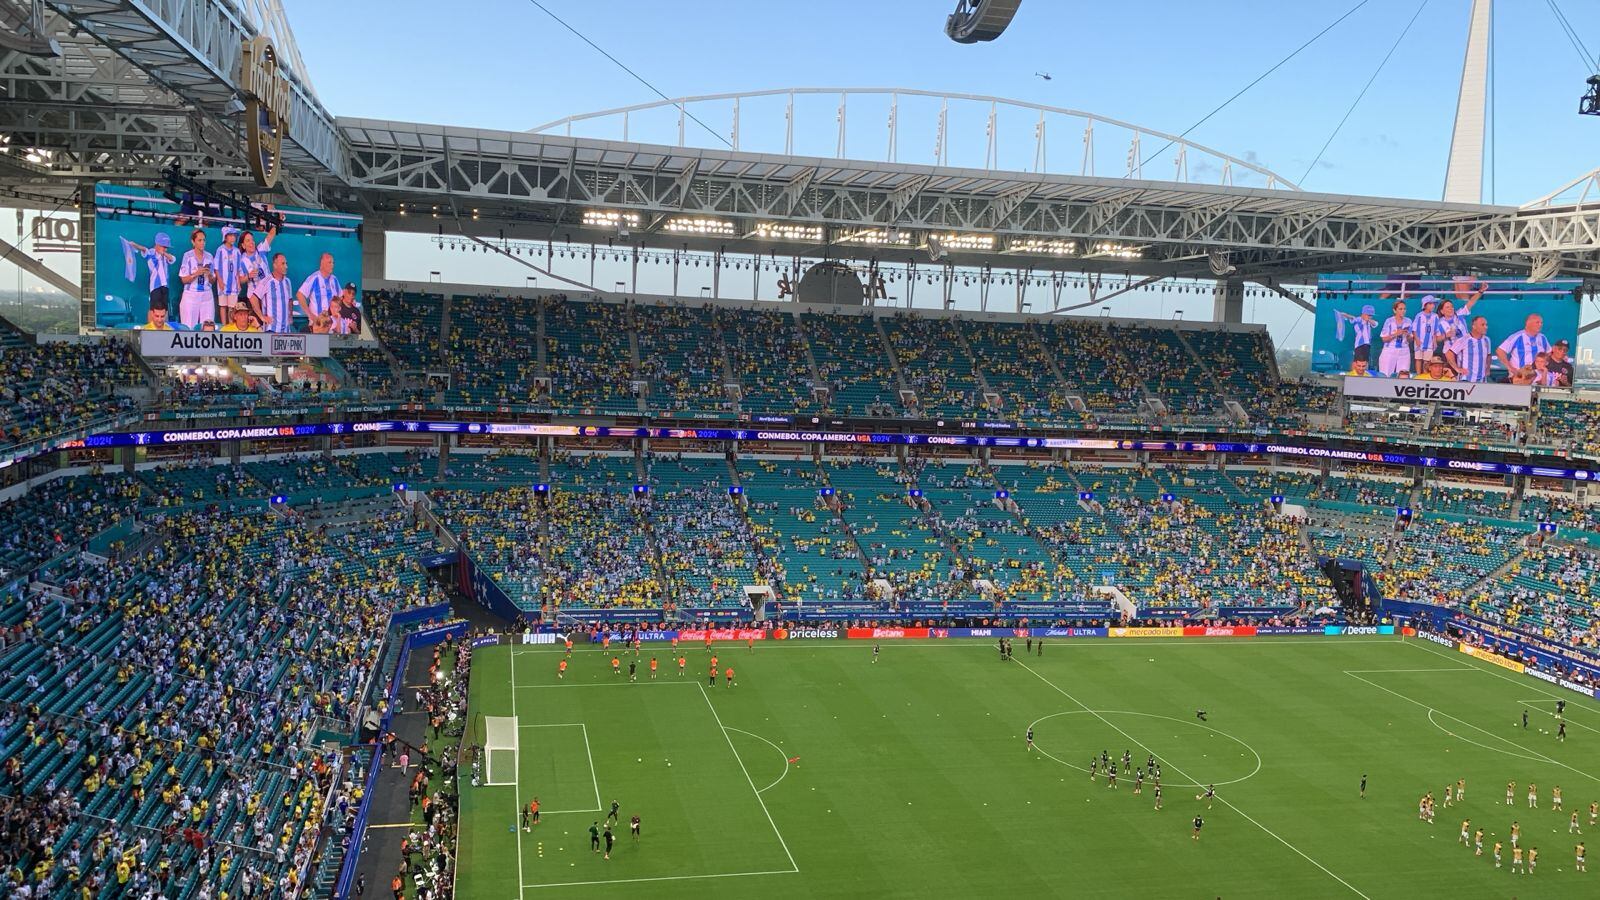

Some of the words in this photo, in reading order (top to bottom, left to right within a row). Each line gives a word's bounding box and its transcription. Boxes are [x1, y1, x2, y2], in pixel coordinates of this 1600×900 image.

[250, 42, 272, 112] Hard
[171, 333, 262, 350] AutoNation
[274, 338, 288, 351] DRV
[290, 339, 304, 351] PNK
[1394, 384, 1465, 401] verizon
[86, 436, 112, 446] 2024
[163, 428, 215, 442] CONMEBOL
[216, 428, 240, 440] COPA
[241, 427, 279, 438] AMERICA
[279, 426, 294, 436] USA
[295, 426, 315, 435] 2024
[698, 430, 717, 438] 2024
[757, 432, 801, 441] CONMEBOL
[801, 433, 822, 441] COPA
[822, 434, 857, 442] AMERICA
[1267, 445, 1308, 455] CONMEBOL
[1309, 448, 1331, 457] COPA
[1331, 451, 1367, 460] AMERICA
[1367, 454, 1383, 462] USA
[523, 633, 556, 644] PUMA
[790, 629, 838, 639] priceless
[873, 629, 904, 637] Betano
[1205, 628, 1234, 636] Betano
[1348, 626, 1377, 635] Degree
[1418, 630, 1453, 648] priceless
[1475, 651, 1504, 665] mercado
[1504, 658, 1519, 670] libre
[1524, 667, 1557, 684] POWERADE
[1559, 679, 1594, 697] POWERADE
